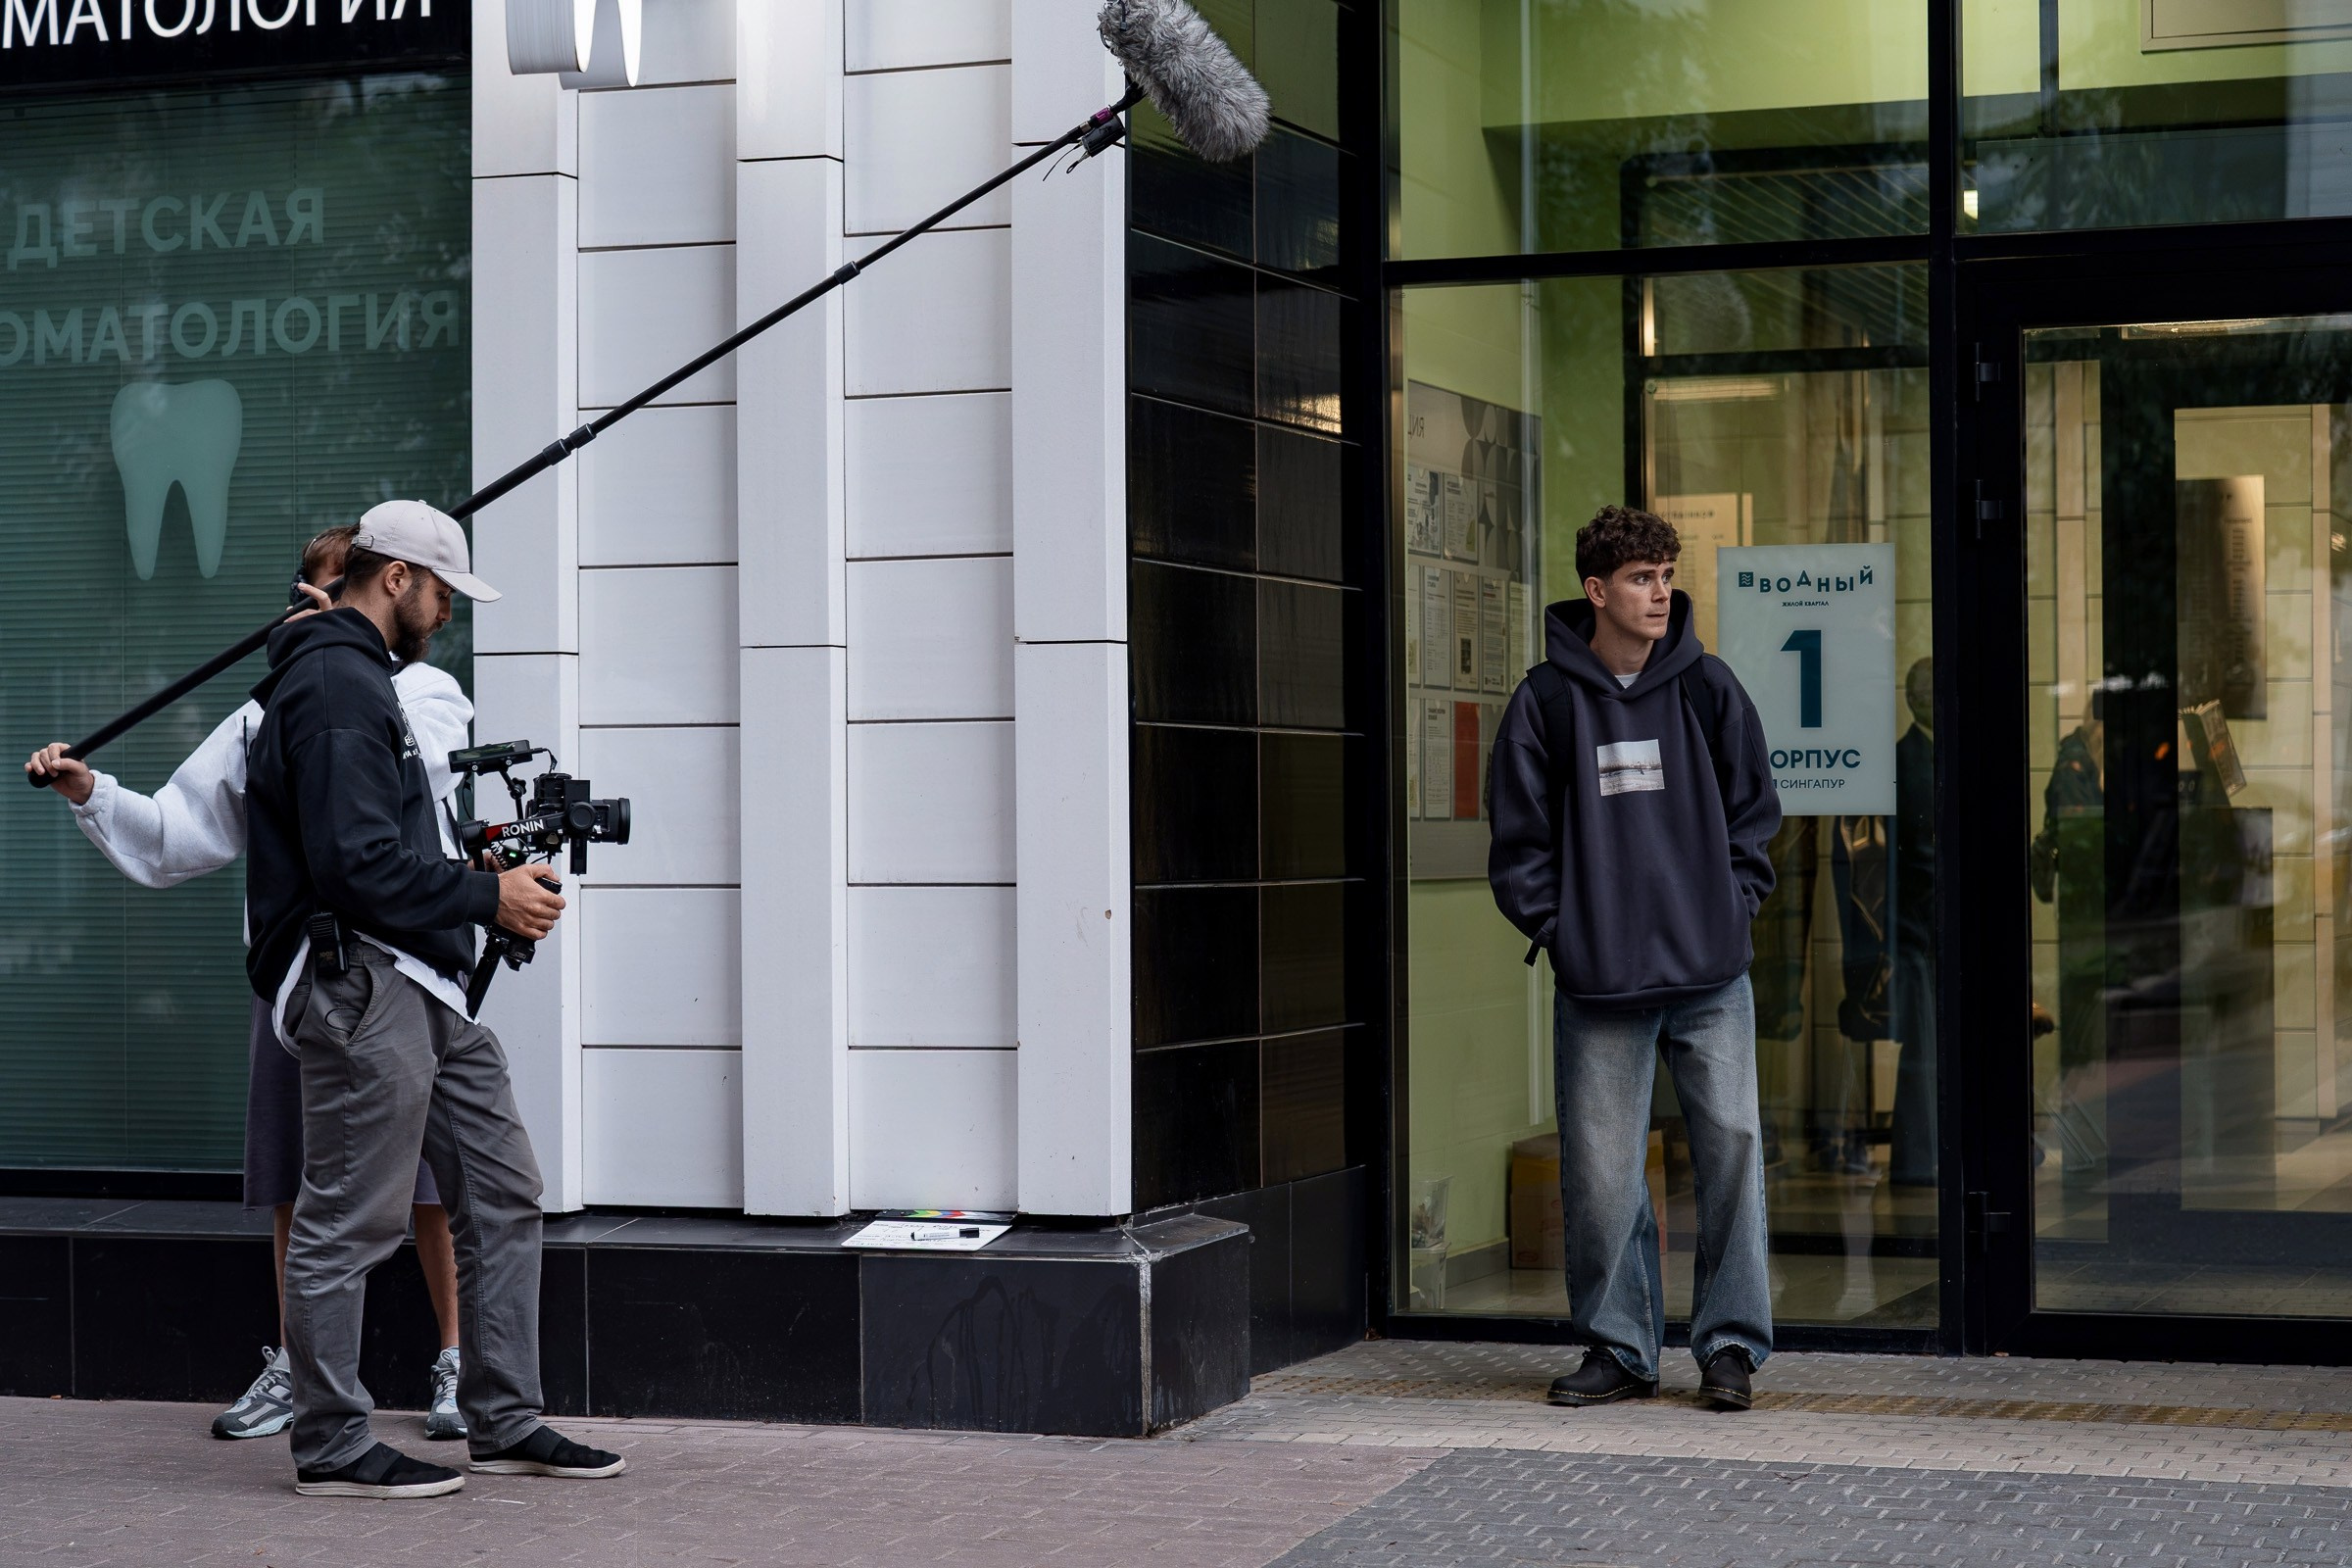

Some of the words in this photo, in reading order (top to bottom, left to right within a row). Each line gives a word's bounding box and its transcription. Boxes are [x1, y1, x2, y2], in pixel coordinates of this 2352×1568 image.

[3, 0, 431, 49] МАТОЛ
[7, 187, 324, 270] ДЕТСКАЯ
[1760, 565, 1873, 593] ВОДНЫЙ
[1780, 629, 1823, 728] 1
[1780, 779, 1845, 789] СИНГАПУР
[502, 818, 545, 838] RONIN
